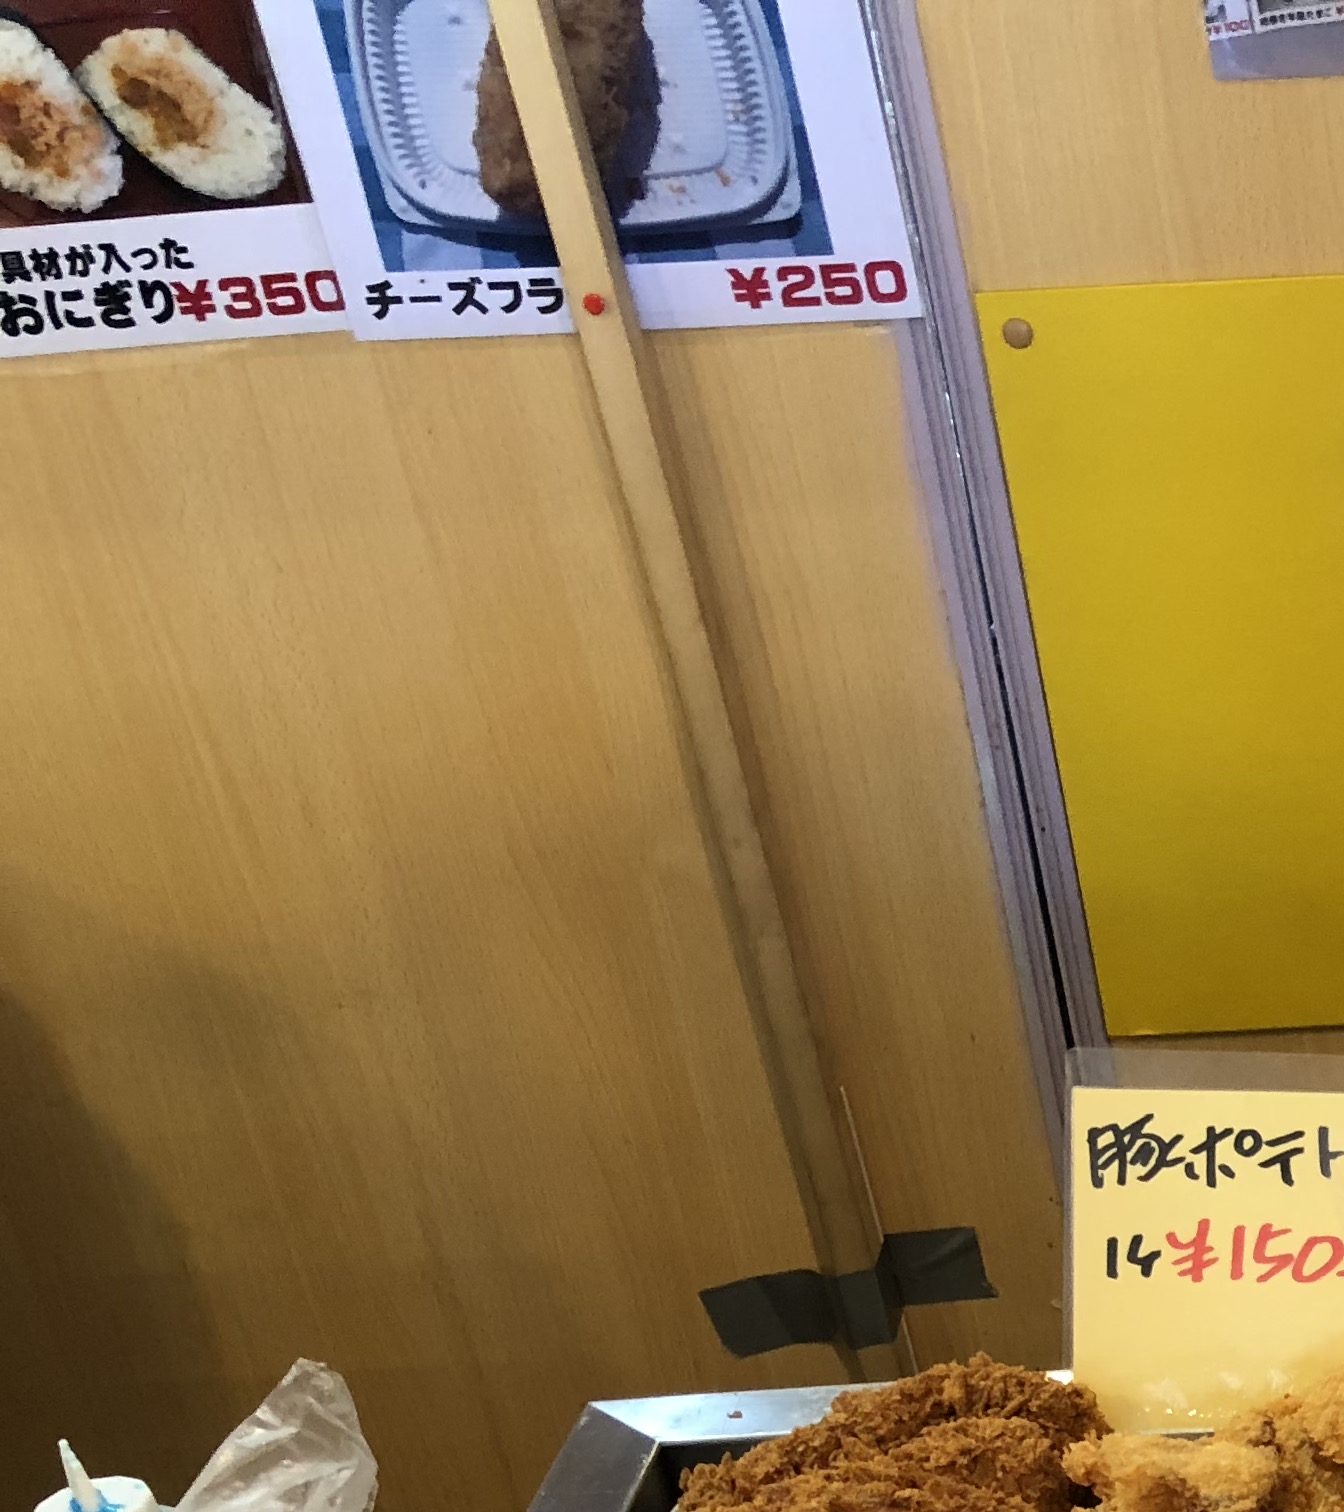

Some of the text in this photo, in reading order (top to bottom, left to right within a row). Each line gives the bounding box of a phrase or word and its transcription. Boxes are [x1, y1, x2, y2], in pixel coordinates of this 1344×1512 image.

[0, 237, 195, 284] 具材が入った
[365, 260, 908, 320] チーズフラ ¥250
[0, 270, 346, 337] おにぎり ¥350
